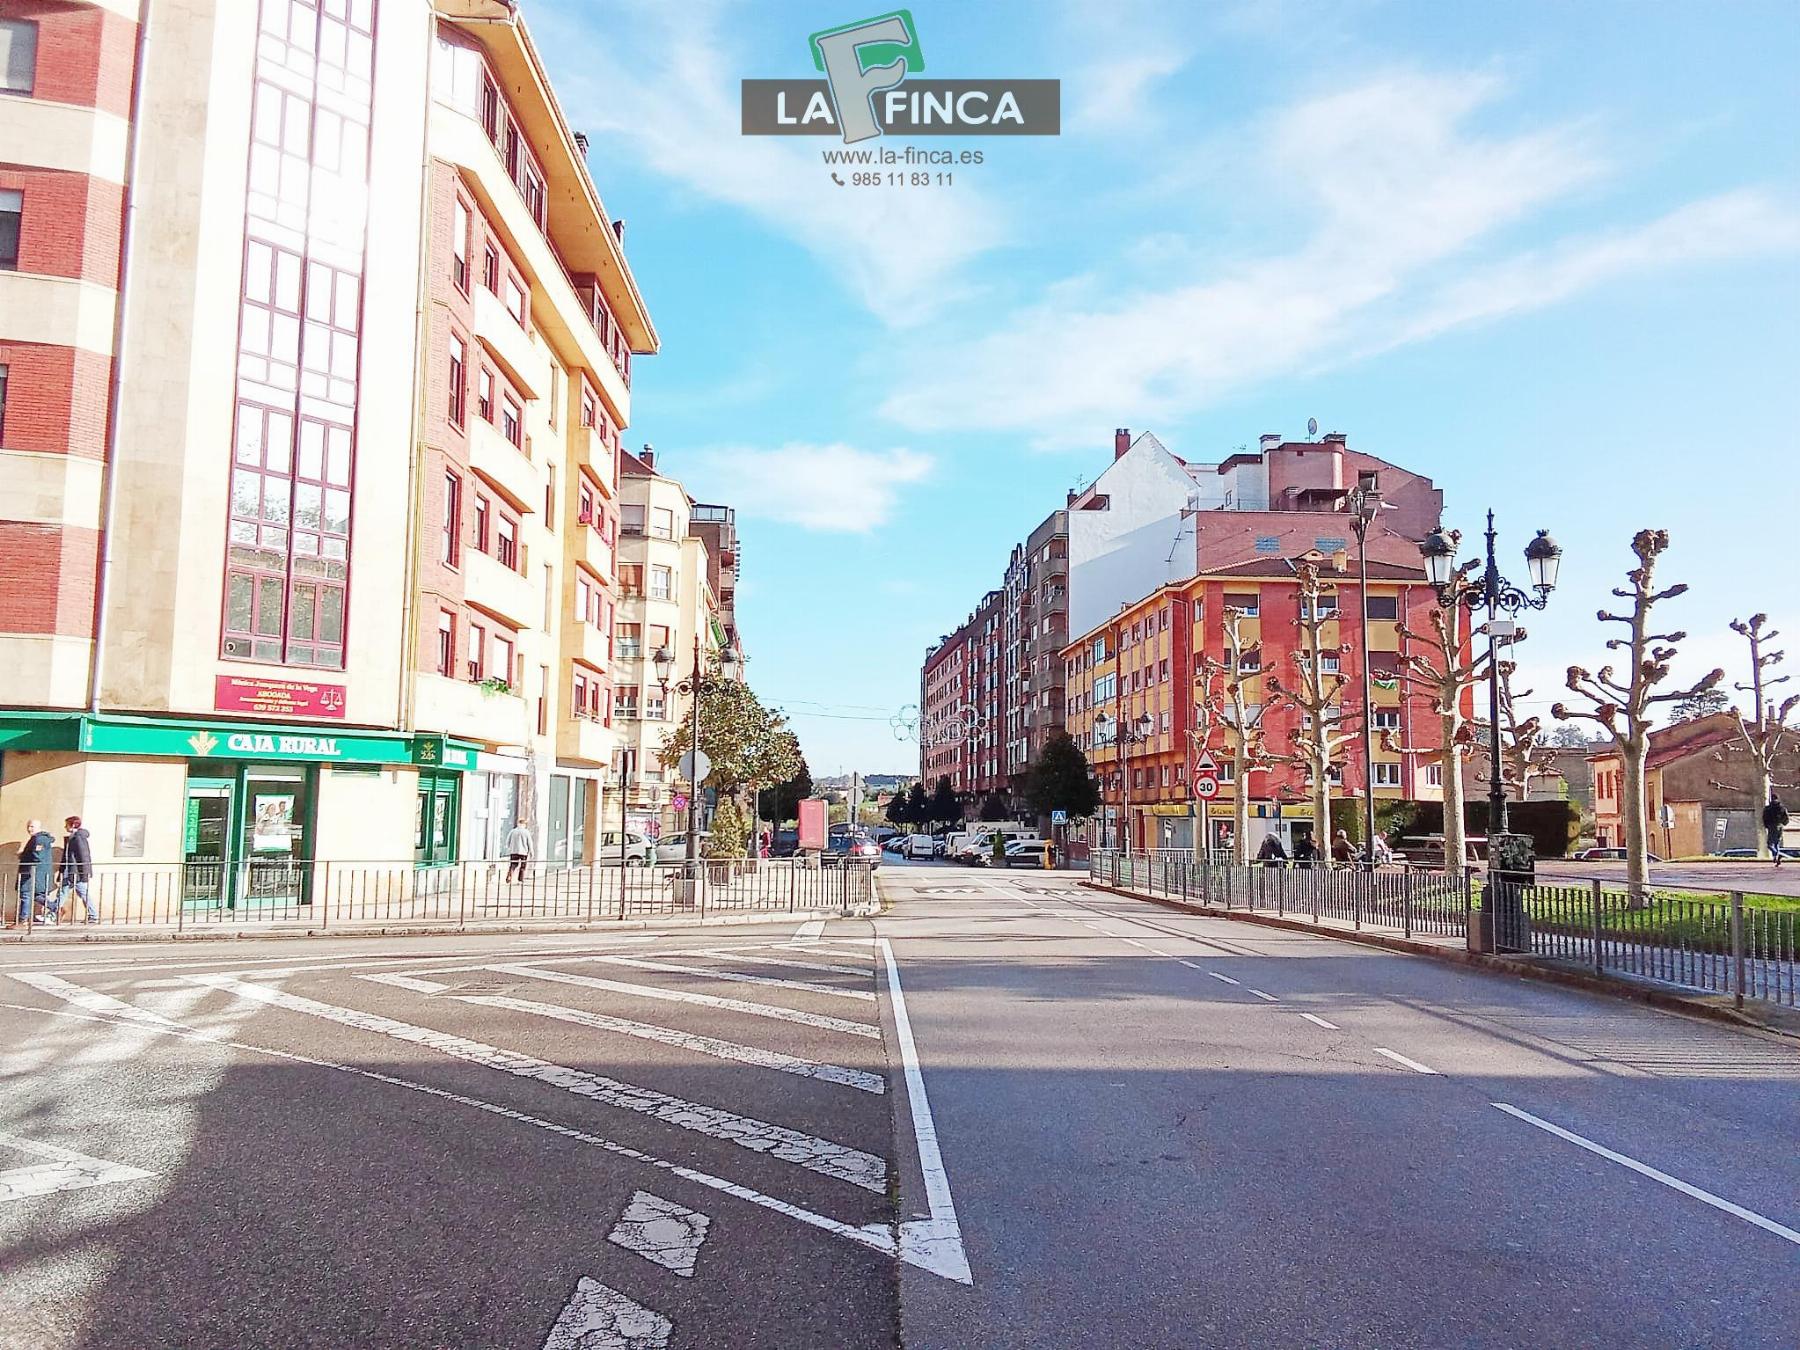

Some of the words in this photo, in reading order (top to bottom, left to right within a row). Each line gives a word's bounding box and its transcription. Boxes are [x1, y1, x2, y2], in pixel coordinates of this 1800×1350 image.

[302, 685, 318, 693] Vega
[257, 690, 292, 699] ABOGADA
[228, 734, 276, 752] CAJA
[279, 736, 341, 755] RURAL
[1200, 783, 1213, 791] 30
